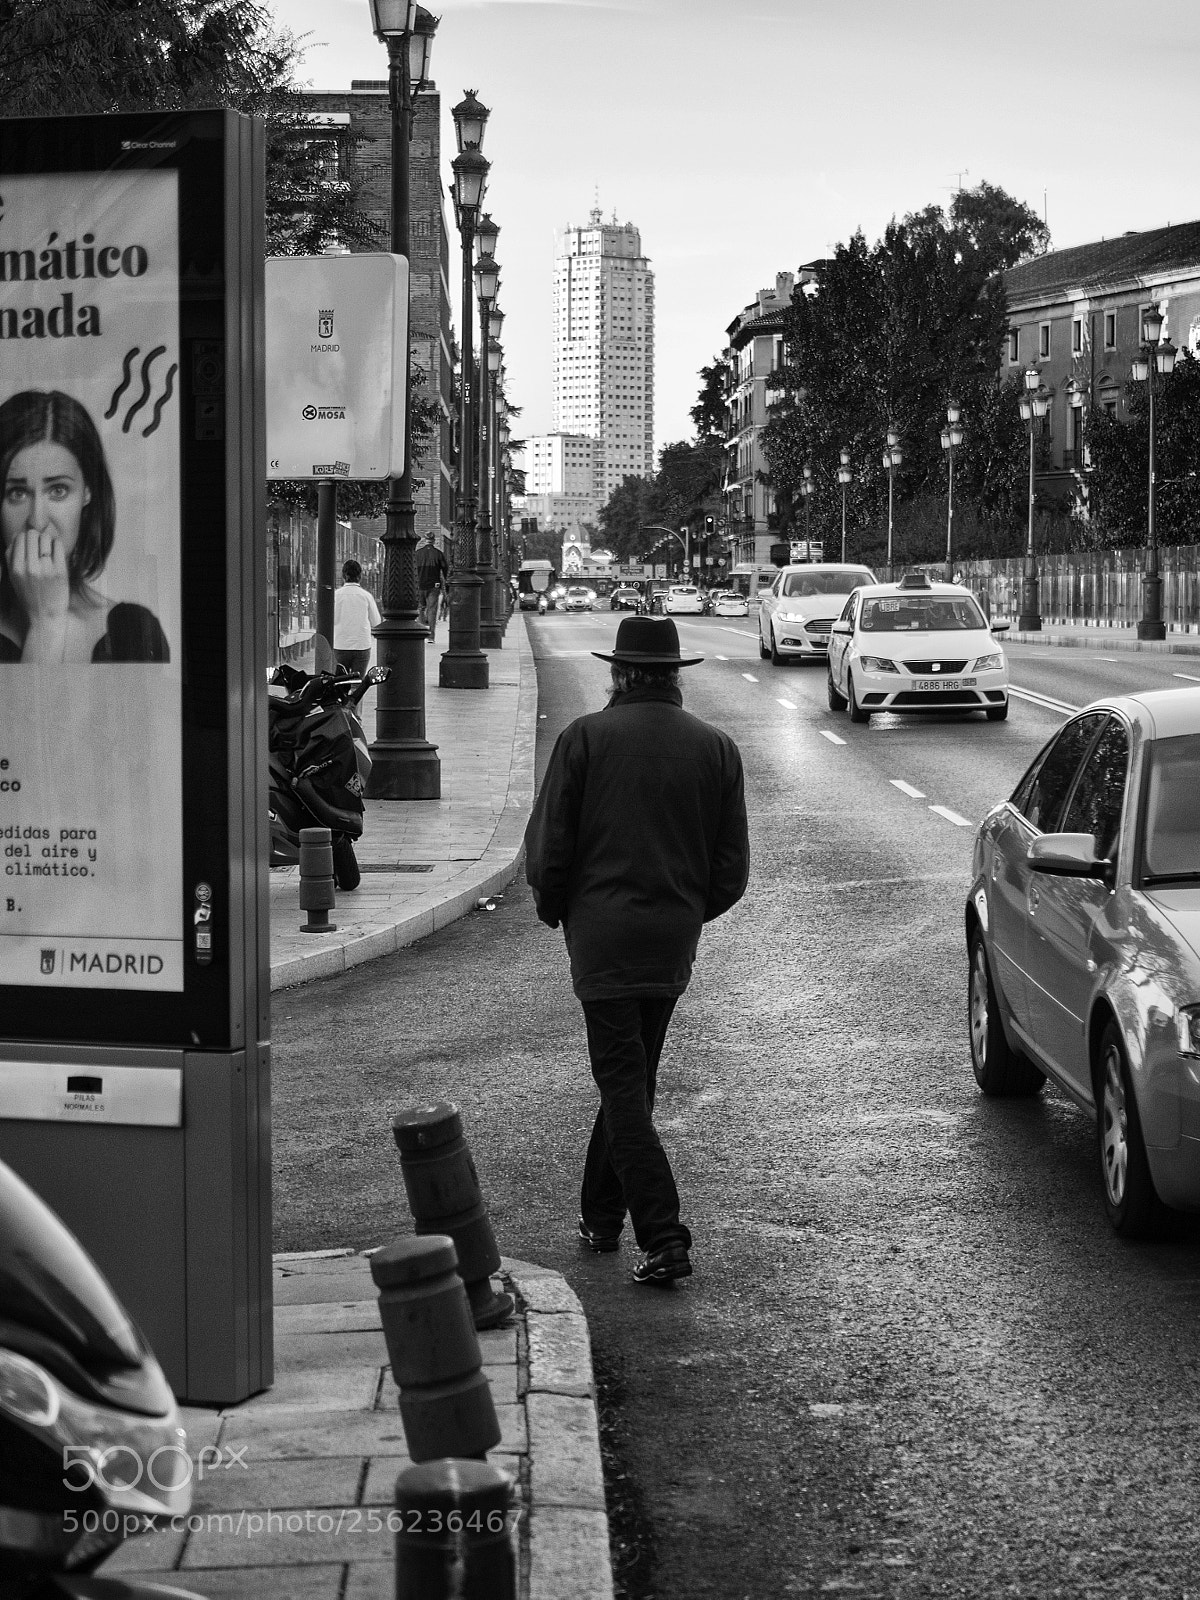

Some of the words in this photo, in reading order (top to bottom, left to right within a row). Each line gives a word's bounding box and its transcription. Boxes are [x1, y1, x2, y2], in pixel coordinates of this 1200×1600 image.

[310, 344, 340, 353] MADRID
[317, 411, 346, 420] MOSA
[918, 682, 940, 690] 4886
[942, 681, 959, 690] HRG
[59, 828, 98, 843] para
[4, 844, 32, 859] del
[41, 845, 79, 859] aire
[87, 848, 98, 862] y
[5, 862, 96, 878] climático.
[6, 898, 23, 913] B.
[70, 952, 164, 975] MADRID
[73, 1094, 96, 1102] PILAS
